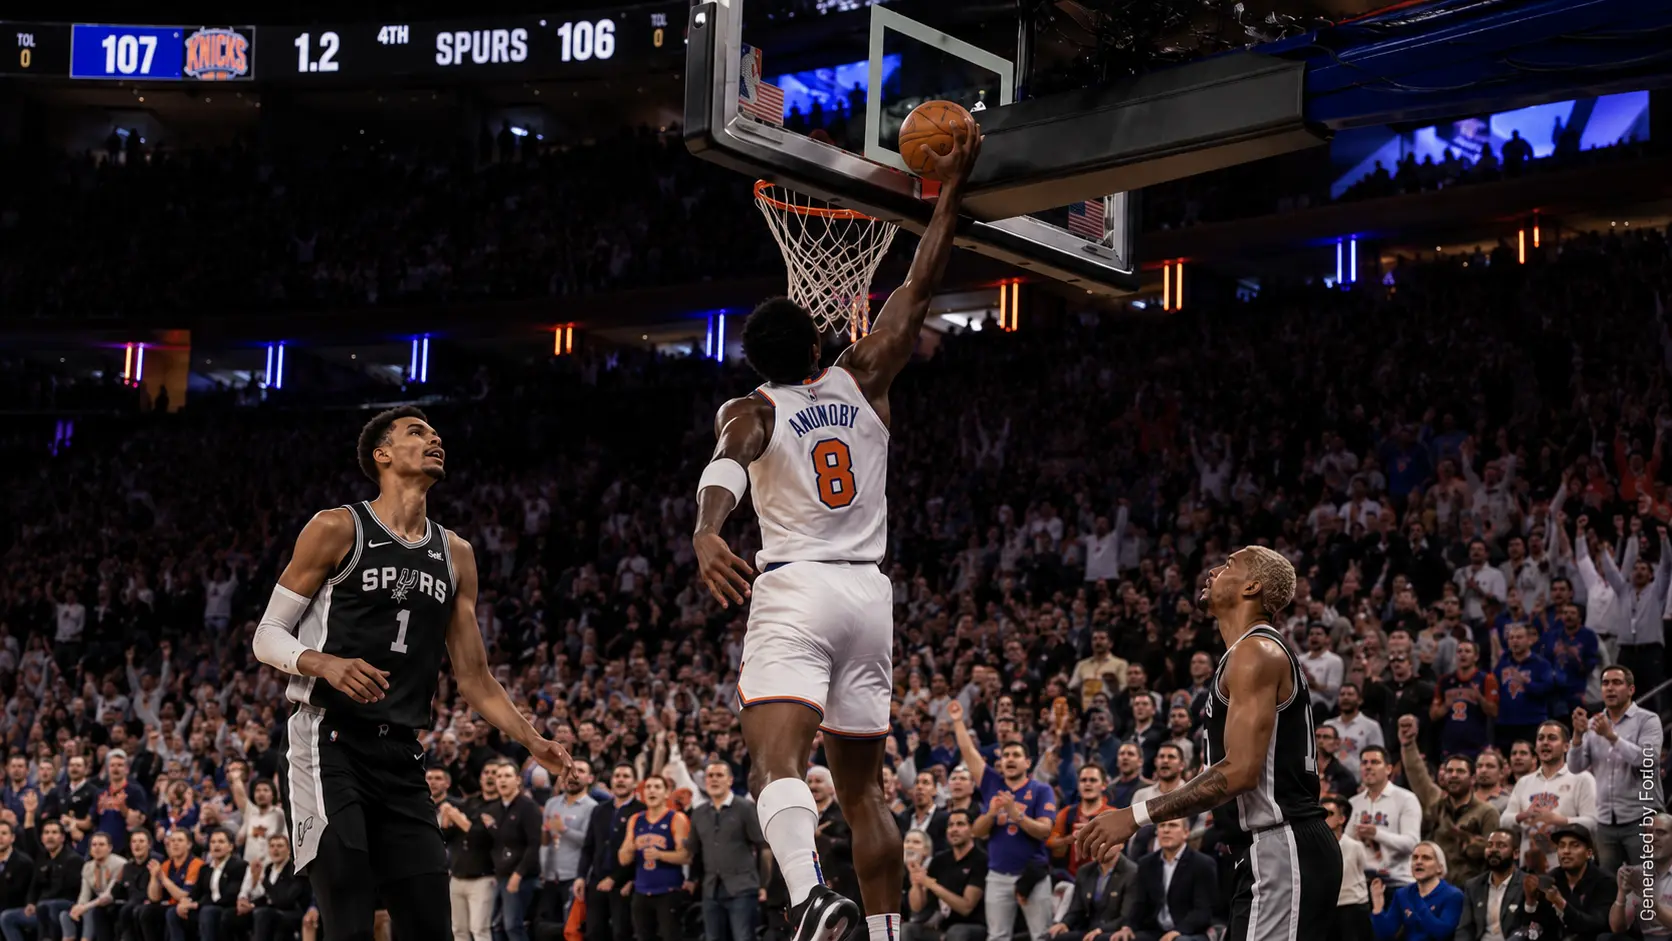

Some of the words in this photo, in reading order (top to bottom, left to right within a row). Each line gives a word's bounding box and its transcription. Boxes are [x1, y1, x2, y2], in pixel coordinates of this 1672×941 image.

[17, 33, 36, 48] TOL
[102, 34, 158, 74] 107
[186, 34, 247, 73] KNICKS
[294, 31, 340, 73] 1.2
[377, 25, 409, 45] 4TH
[435, 28, 529, 66] SPURS
[557, 18, 616, 62] 106
[653, 28, 664, 48] 0
[20, 48, 31, 68] 0
[788, 403, 860, 438] ANUNOBY
[811, 437, 858, 510] 8
[362, 566, 447, 604] SPURS
[390, 608, 411, 654] 1
[1451, 701, 1468, 722] 2
